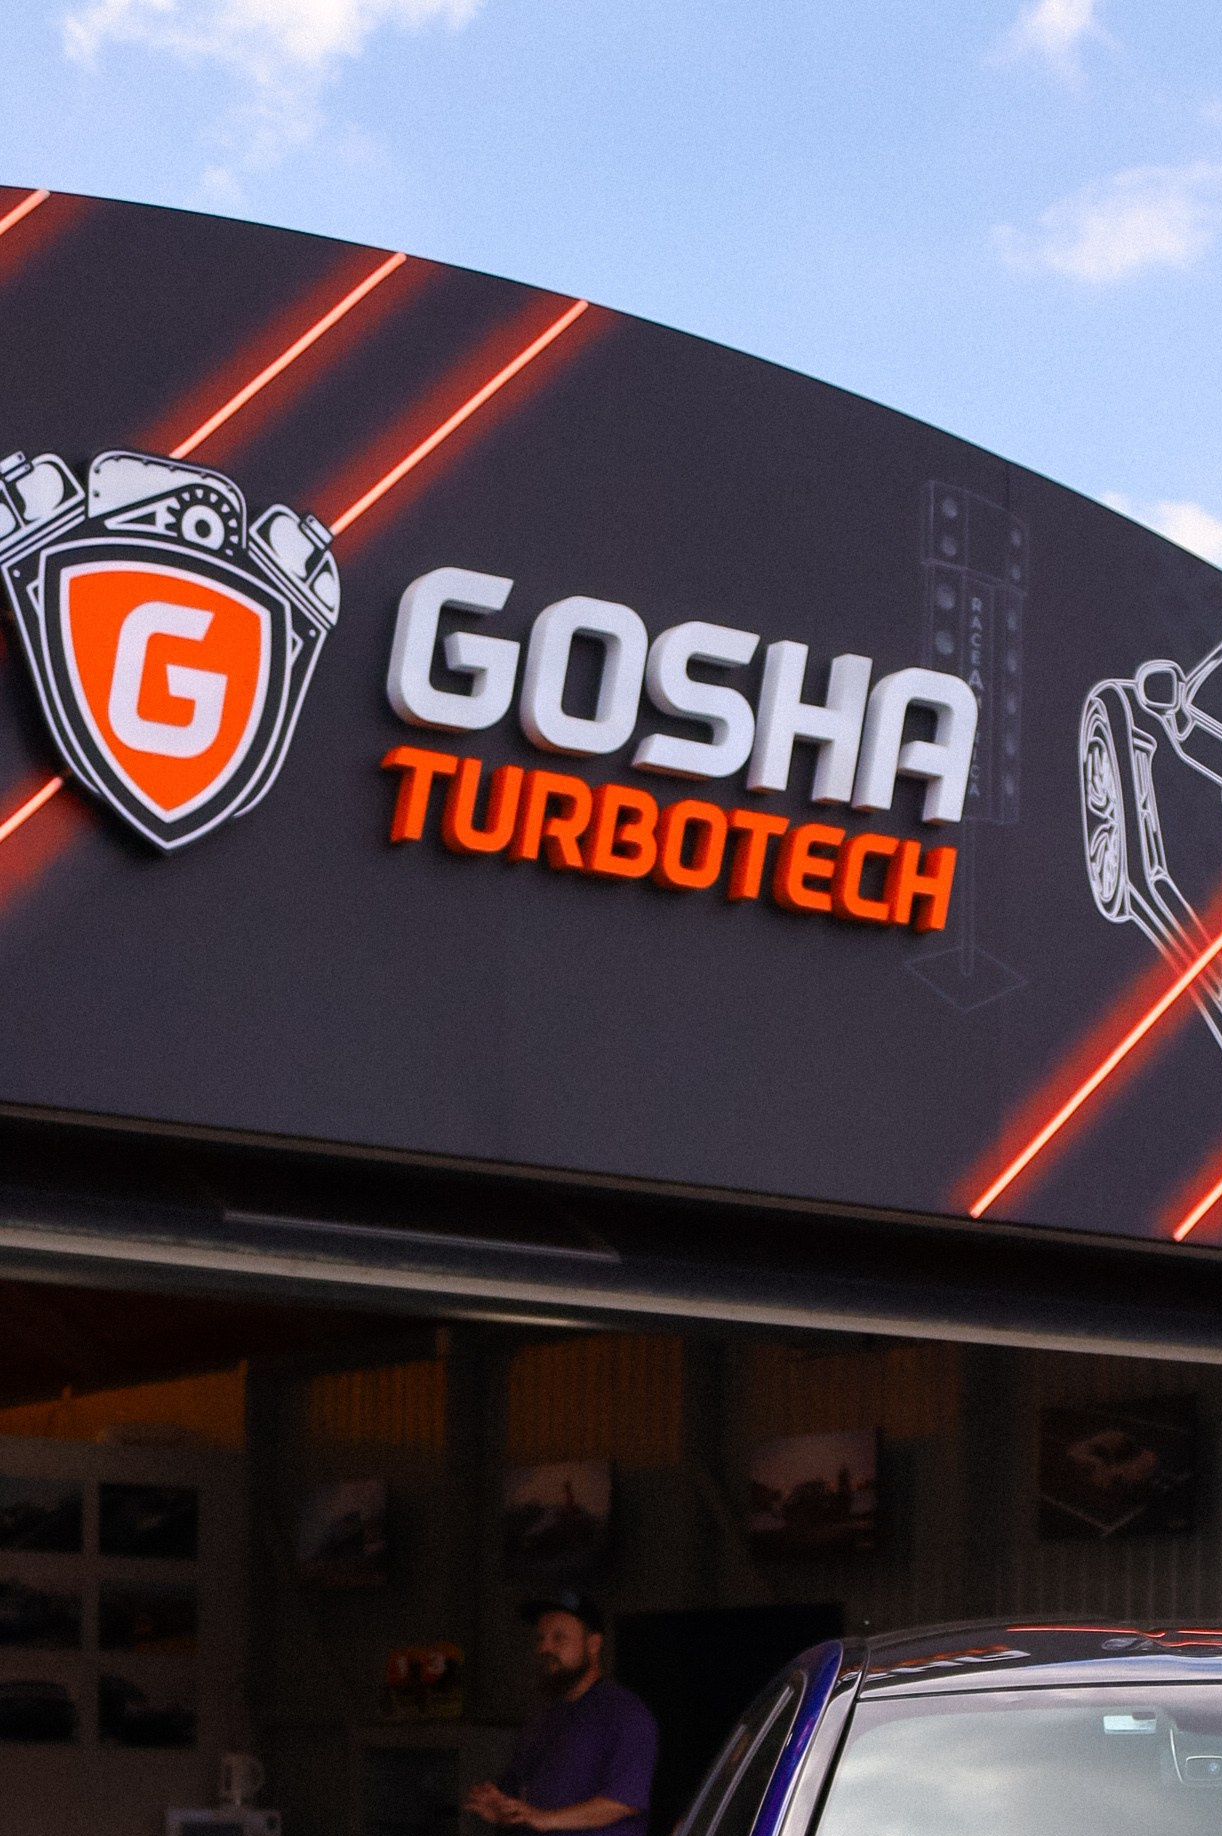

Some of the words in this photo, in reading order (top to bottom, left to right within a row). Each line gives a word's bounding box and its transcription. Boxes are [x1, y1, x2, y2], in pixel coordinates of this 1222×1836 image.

[108, 601, 228, 759] G
[387, 567, 978, 824] GOSHA
[381, 745, 957, 932] TURBOTECH
